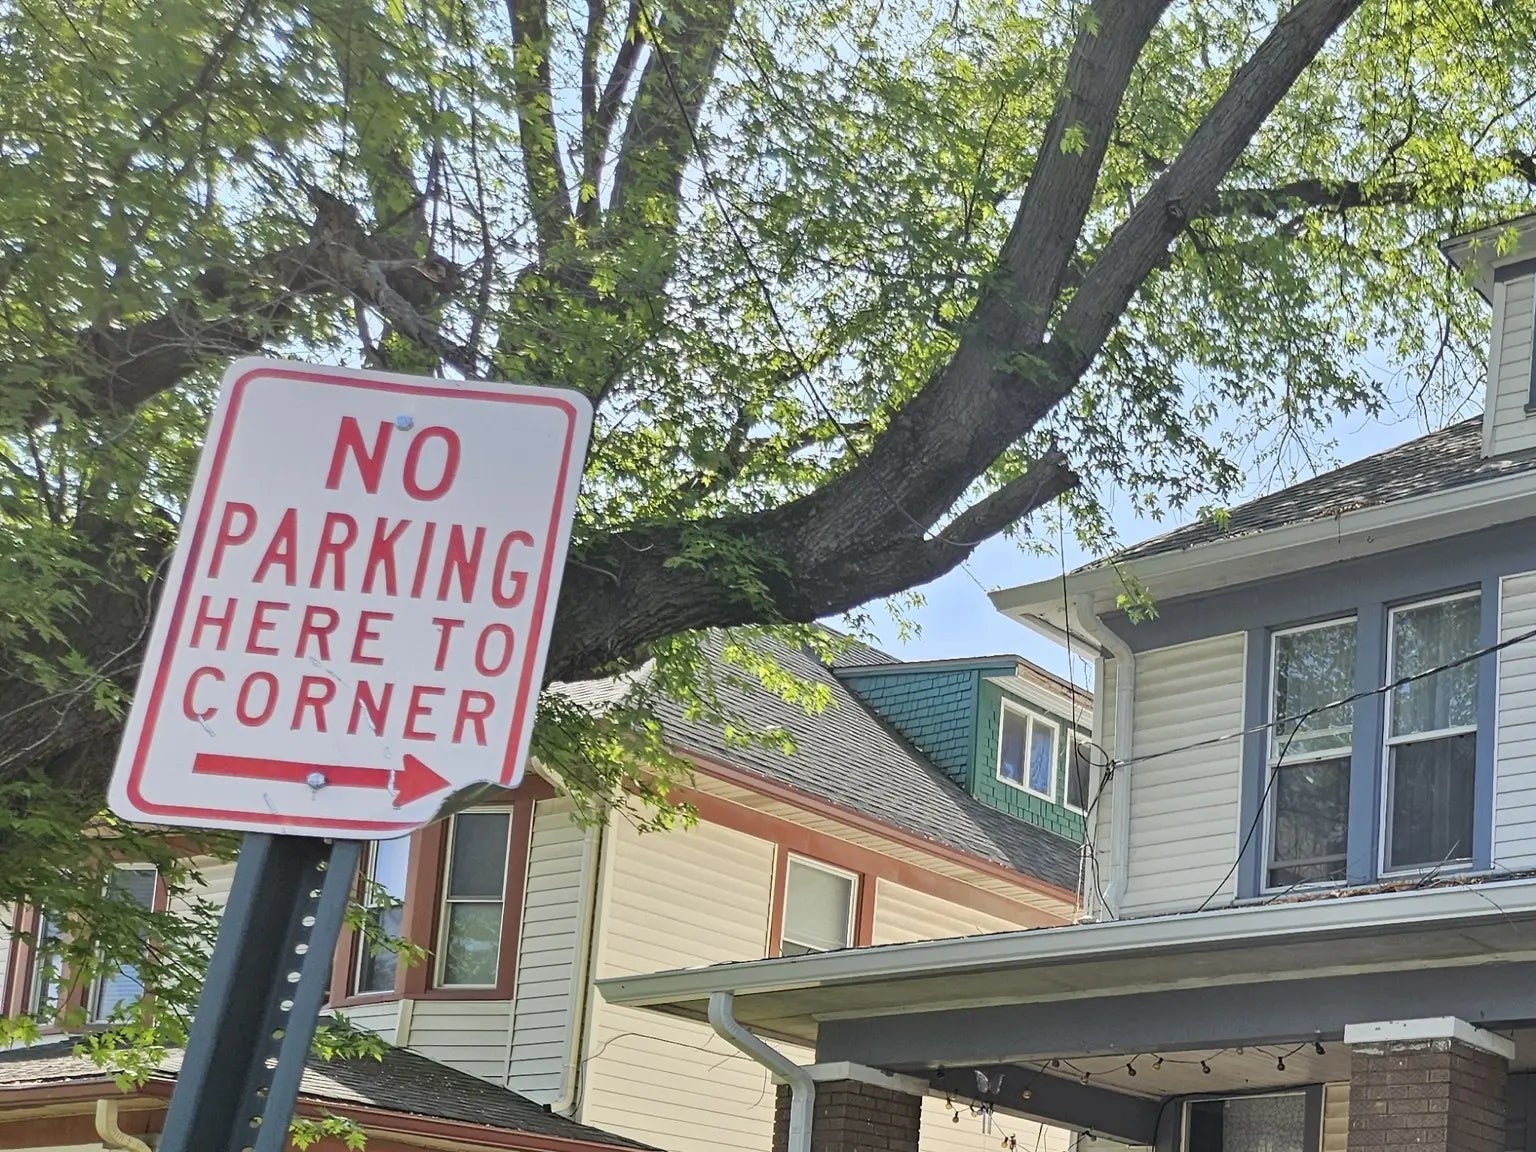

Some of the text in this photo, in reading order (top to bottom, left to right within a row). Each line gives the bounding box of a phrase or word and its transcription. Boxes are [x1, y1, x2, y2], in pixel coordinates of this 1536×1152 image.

[326, 415, 461, 501] NO
[207, 501, 535, 609] PARKING
[188, 595, 515, 678] HERE TO
[183, 666, 496, 746] CORNER
